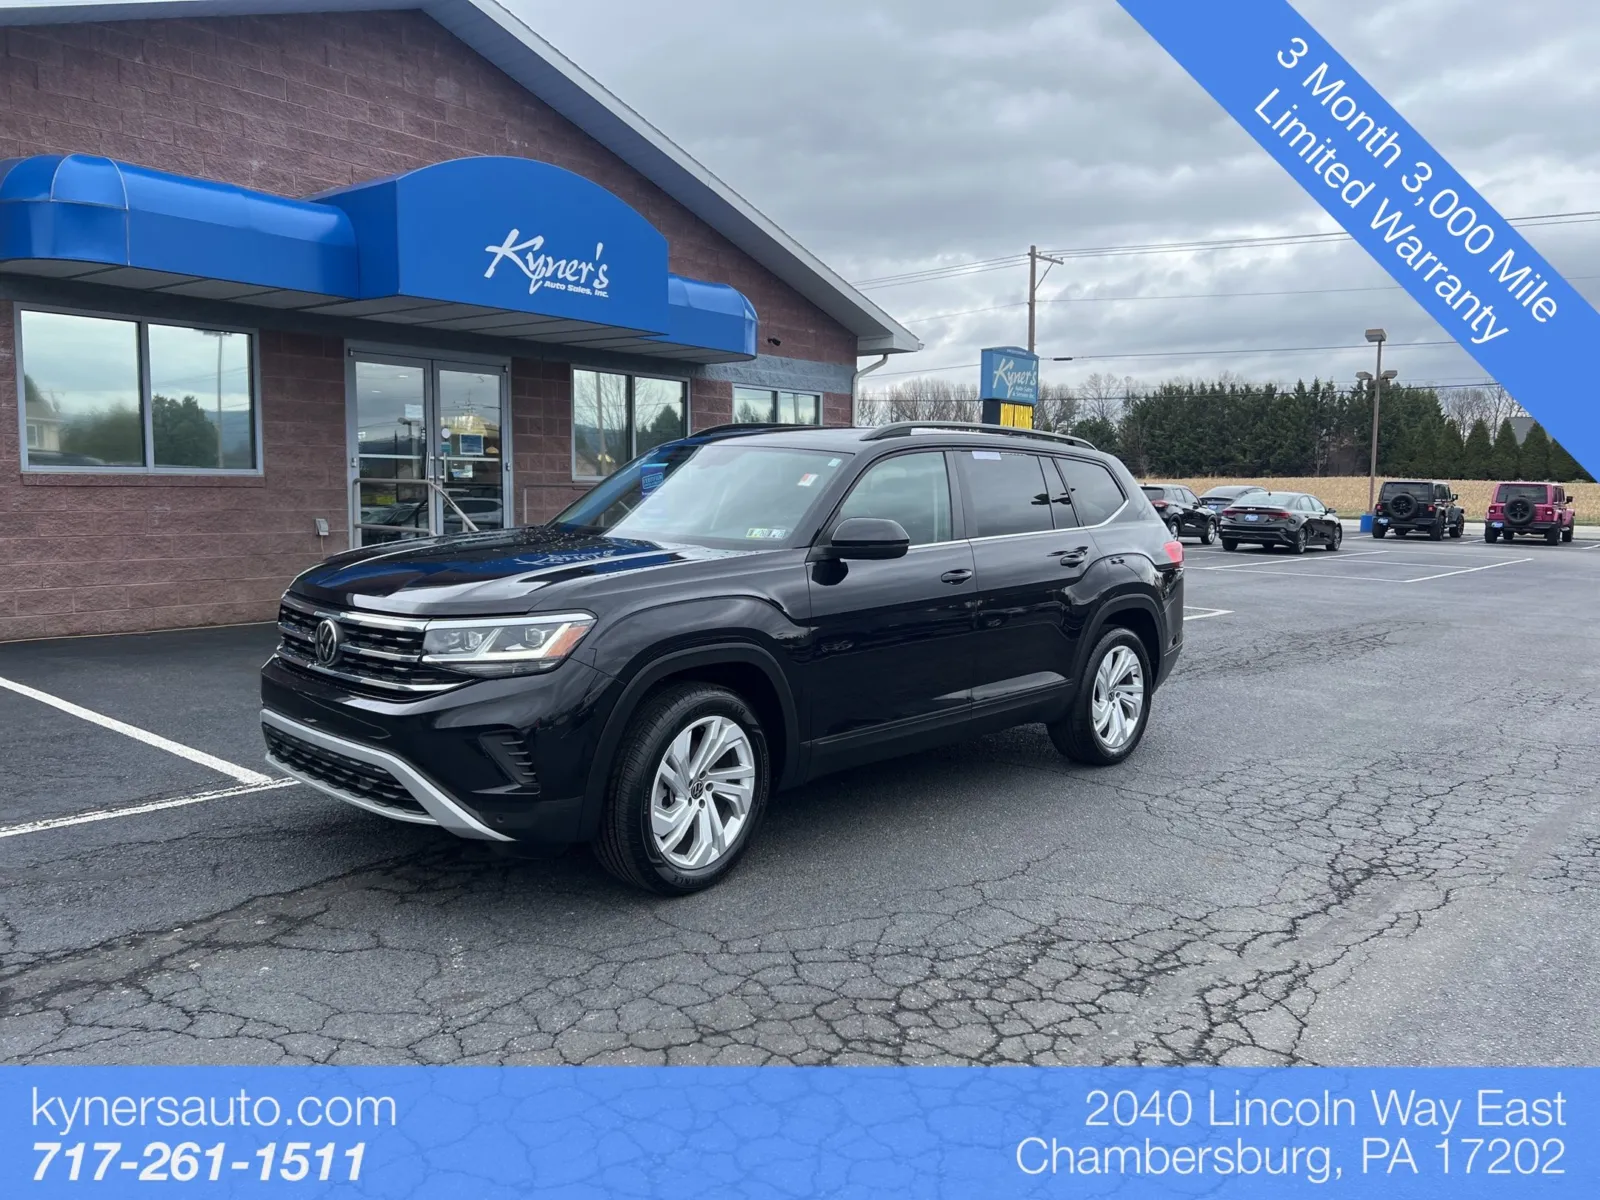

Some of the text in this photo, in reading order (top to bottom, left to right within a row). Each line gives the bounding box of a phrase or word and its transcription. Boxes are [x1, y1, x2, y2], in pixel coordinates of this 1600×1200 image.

[484, 228, 609, 295] Kyner's
[544, 280, 566, 290] Auto
[567, 284, 592, 295] Sales,
[993, 358, 1037, 399] Kyner's
